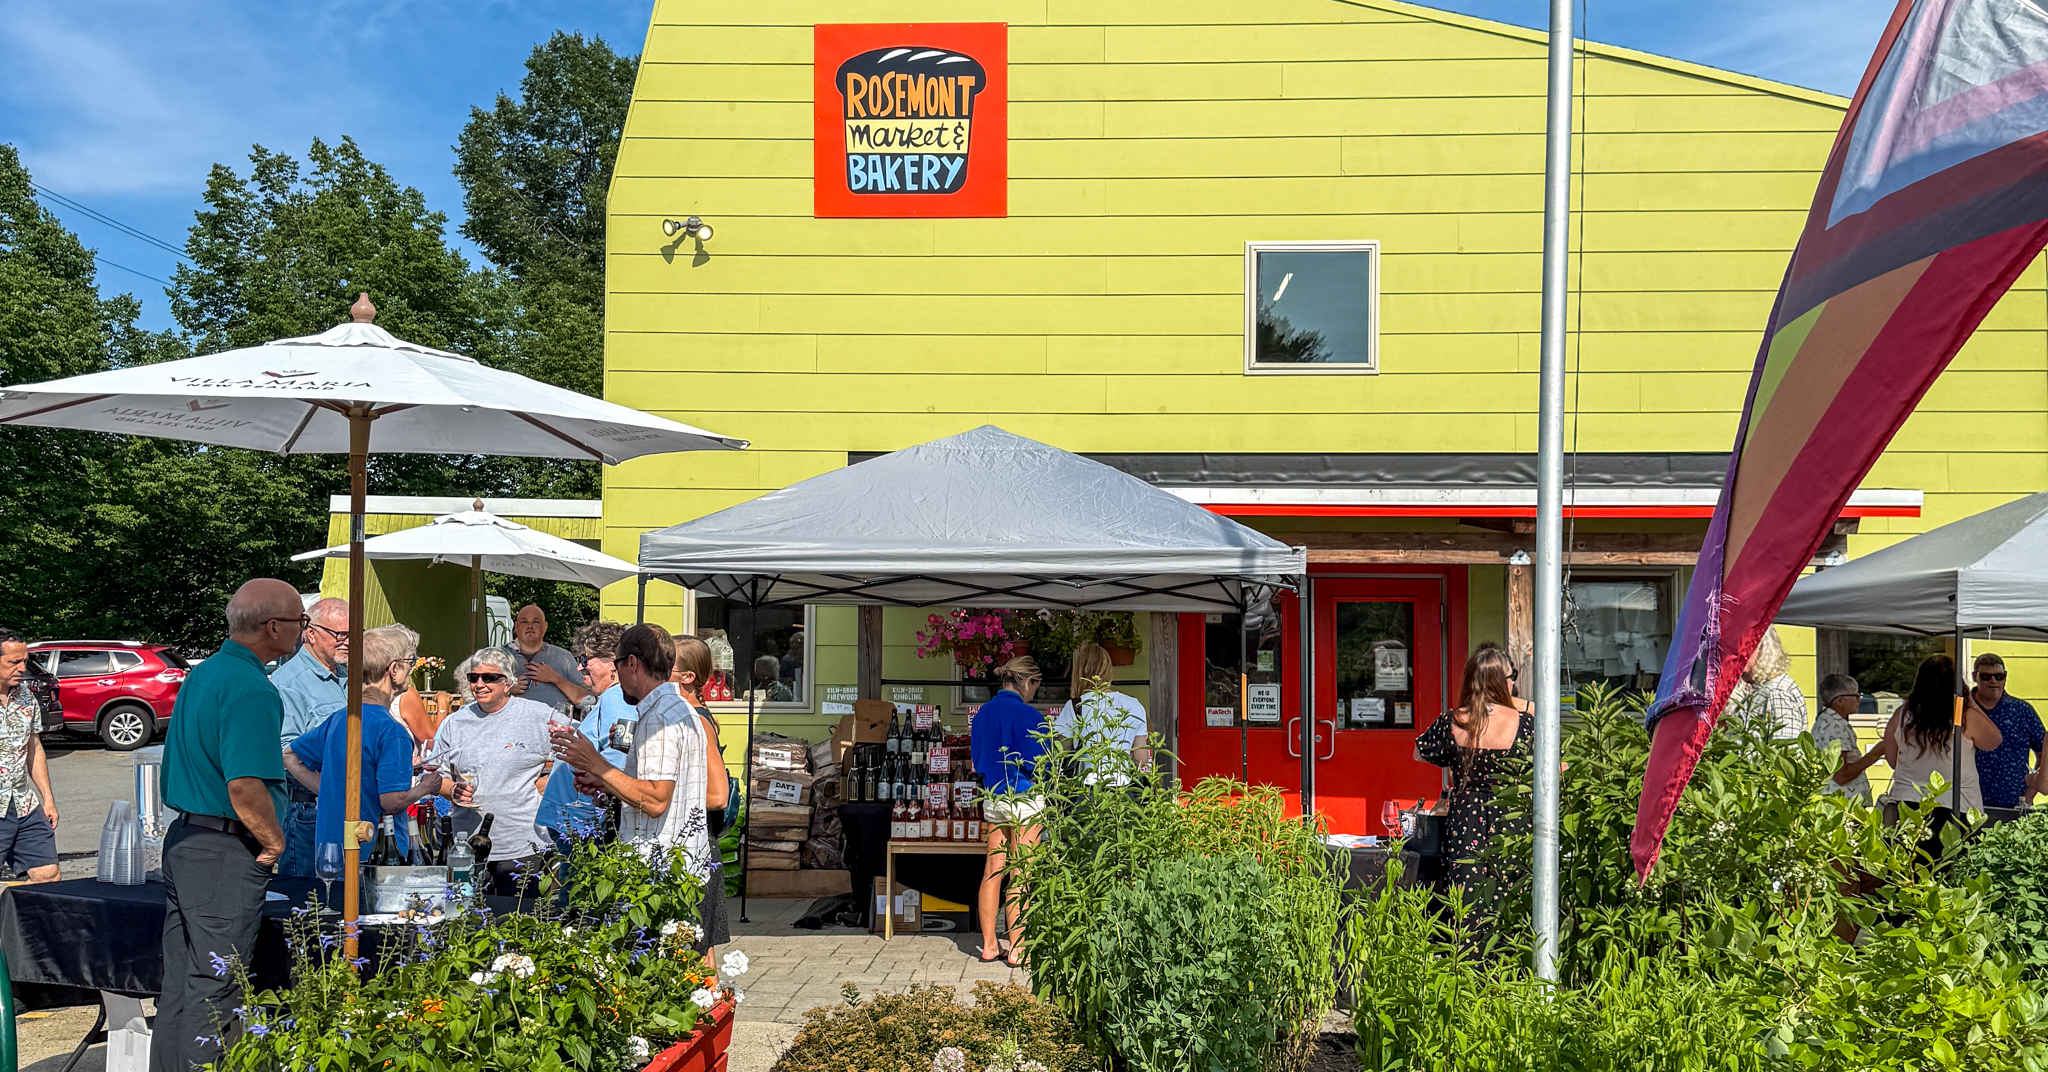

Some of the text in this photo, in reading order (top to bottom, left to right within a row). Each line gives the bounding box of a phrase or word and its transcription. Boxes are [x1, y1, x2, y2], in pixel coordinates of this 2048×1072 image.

[846, 70, 976, 118] ROSEMONT
[848, 121, 965, 150] Market &
[849, 154, 965, 191] BAKERY
[170, 376, 373, 388] VILLA MARIA
